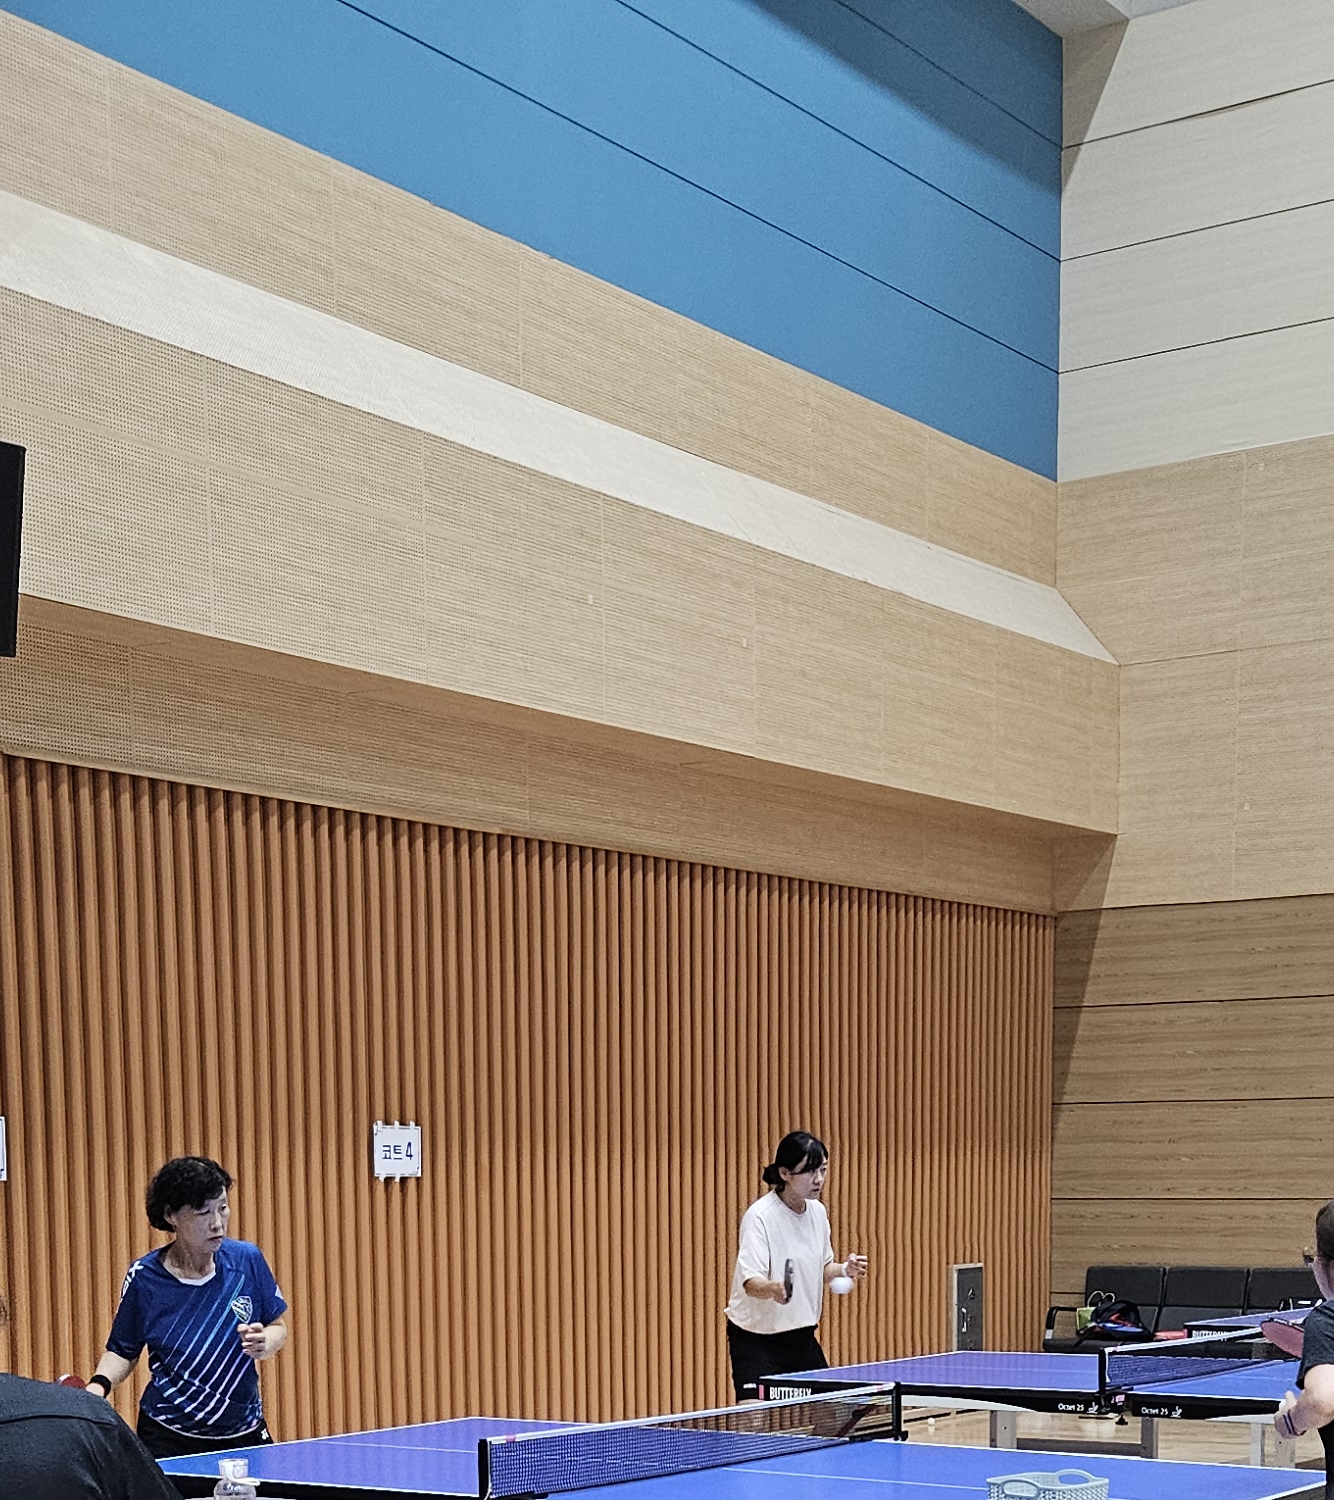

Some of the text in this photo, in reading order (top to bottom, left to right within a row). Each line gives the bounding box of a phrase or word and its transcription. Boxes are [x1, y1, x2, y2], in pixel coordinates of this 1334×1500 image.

[382, 1141, 414, 1161] 코트 4
[1058, 1402, 1085, 1412] Octet 25
[1141, 1406, 1169, 1416] Octet 25
